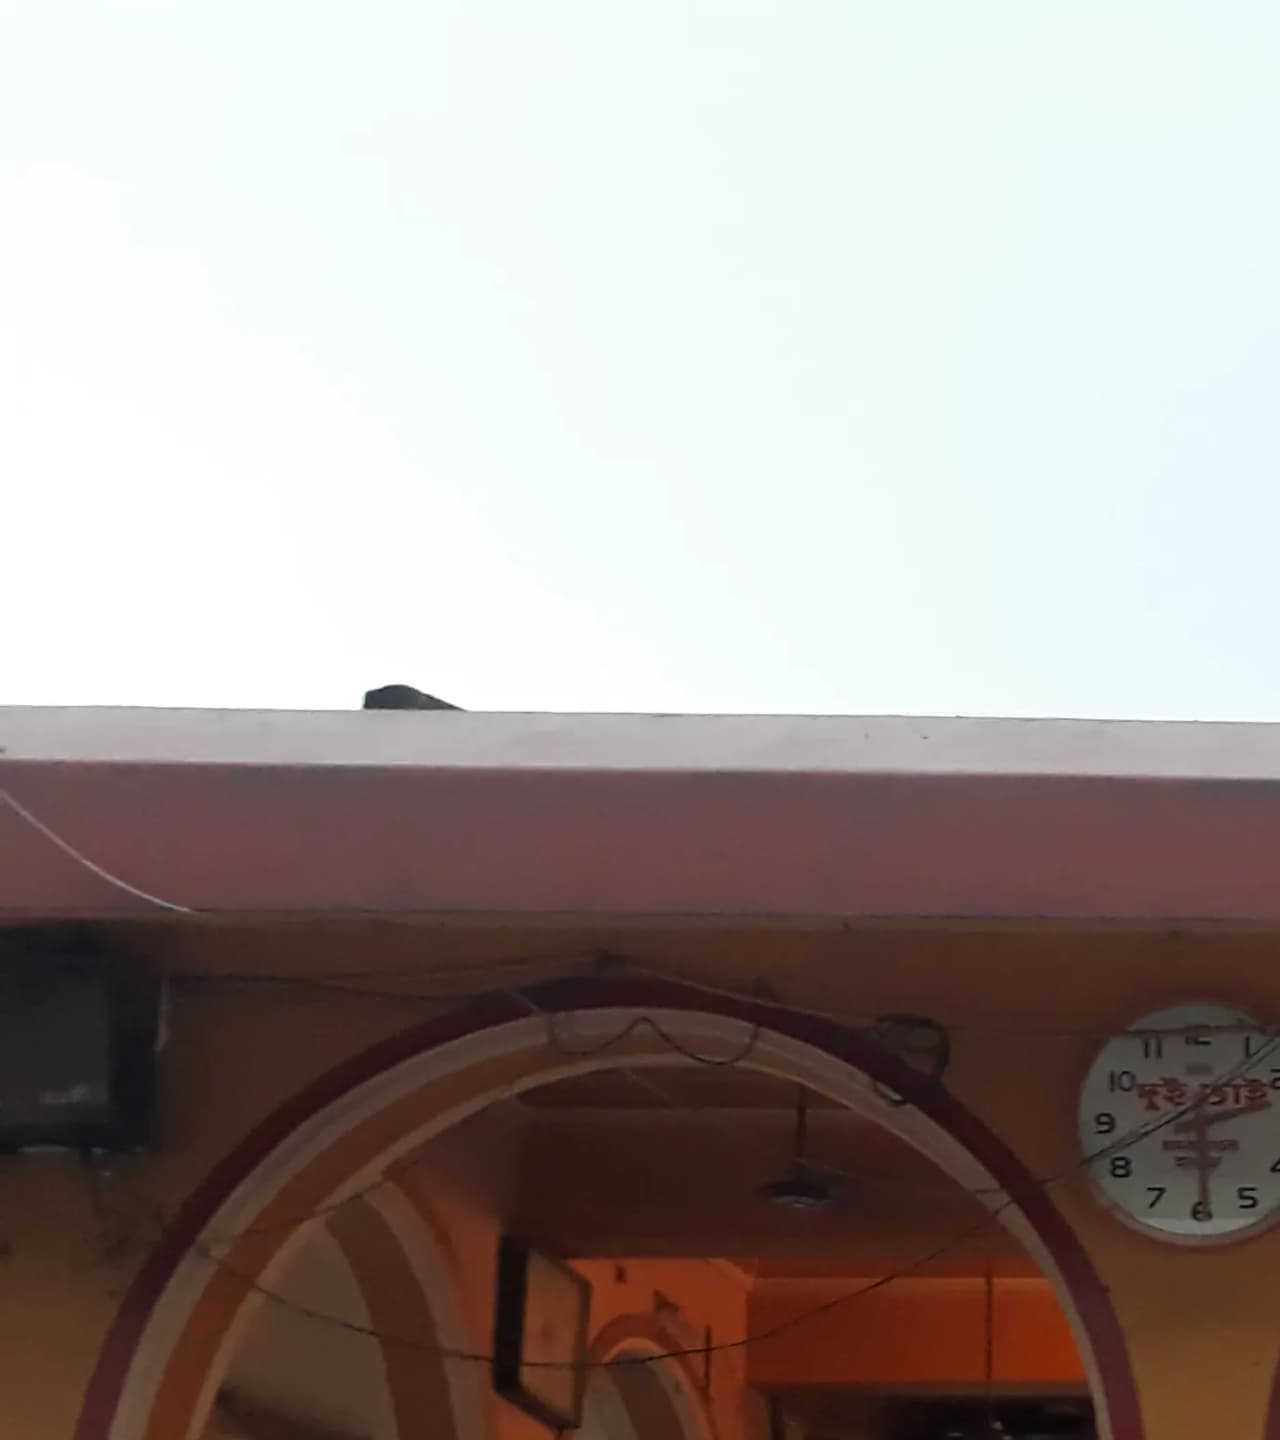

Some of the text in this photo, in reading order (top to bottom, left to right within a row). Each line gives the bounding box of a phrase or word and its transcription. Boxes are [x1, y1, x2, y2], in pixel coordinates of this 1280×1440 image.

[1143, 1035, 1163, 1058] 11
[1245, 1036, 1253, 1057] 1
[1109, 1070, 1136, 1092] 10
[1095, 1112, 1115, 1134] 9
[1110, 1156, 1132, 1179] 8
[1147, 1187, 1166, 1209] 7
[1238, 1187, 1258, 1209] 5
[1191, 1201, 1213, 1222] 6
